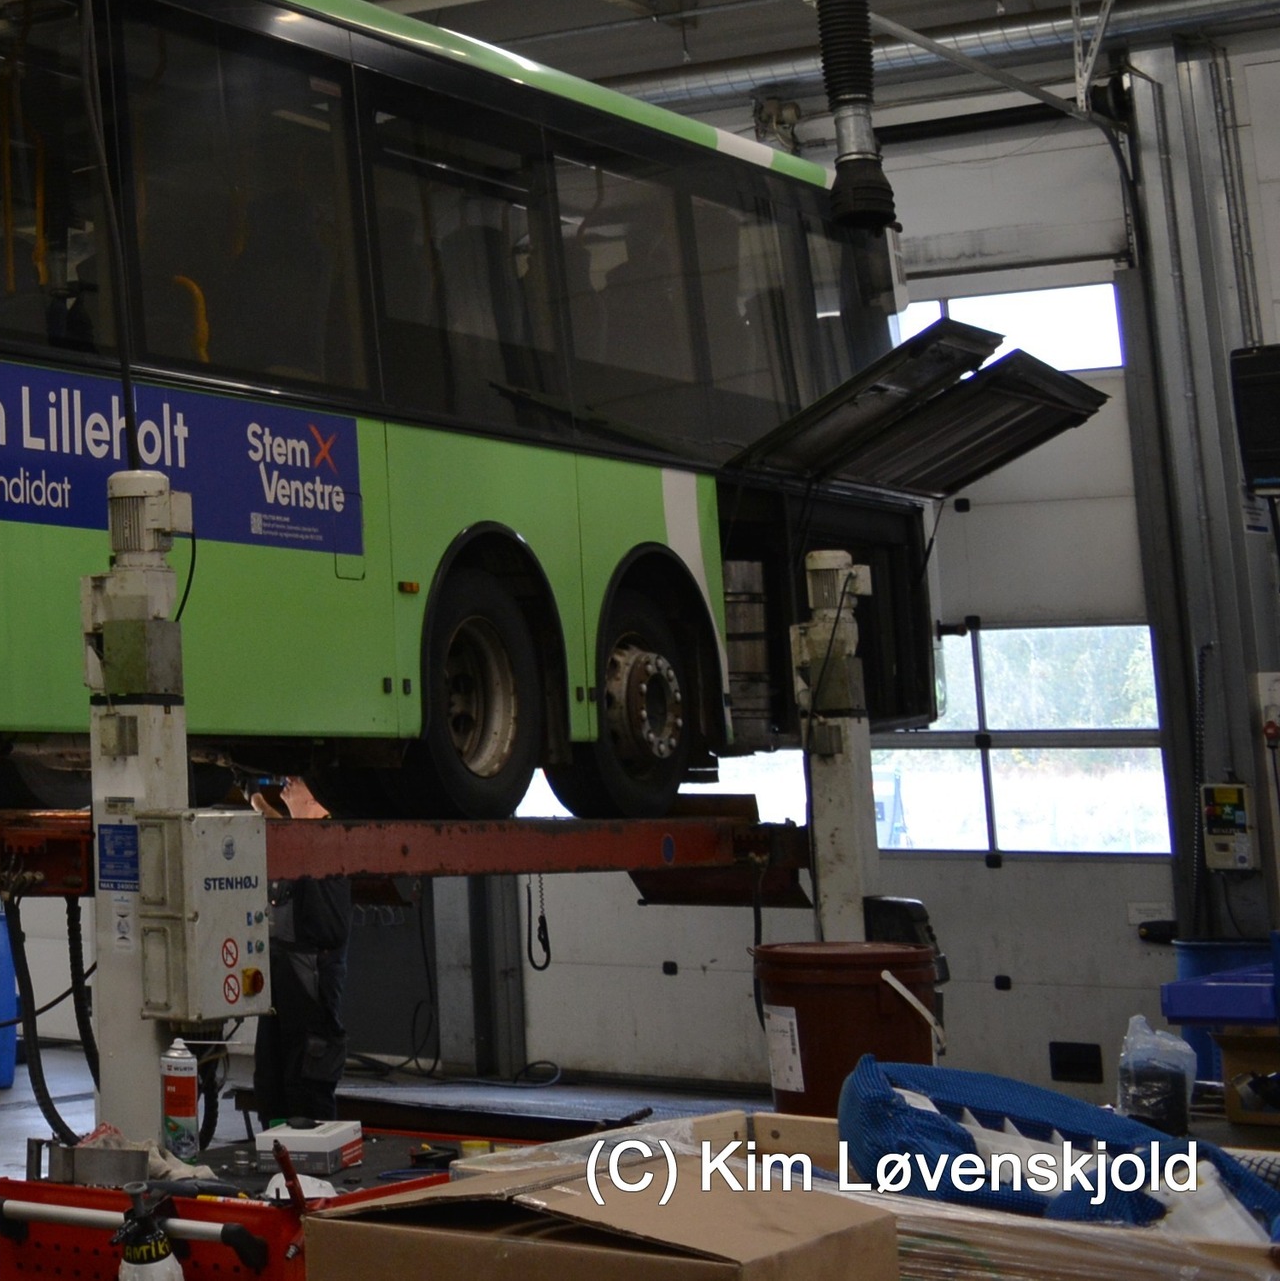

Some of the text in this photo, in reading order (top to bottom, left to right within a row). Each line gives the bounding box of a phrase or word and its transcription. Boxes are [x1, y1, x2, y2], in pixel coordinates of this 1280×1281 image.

[21, 385, 189, 469] Lilleholt
[246, 422, 310, 469] Stem
[258, 461, 345, 513] Venstre
[204, 875, 259, 892] STENHØJ
